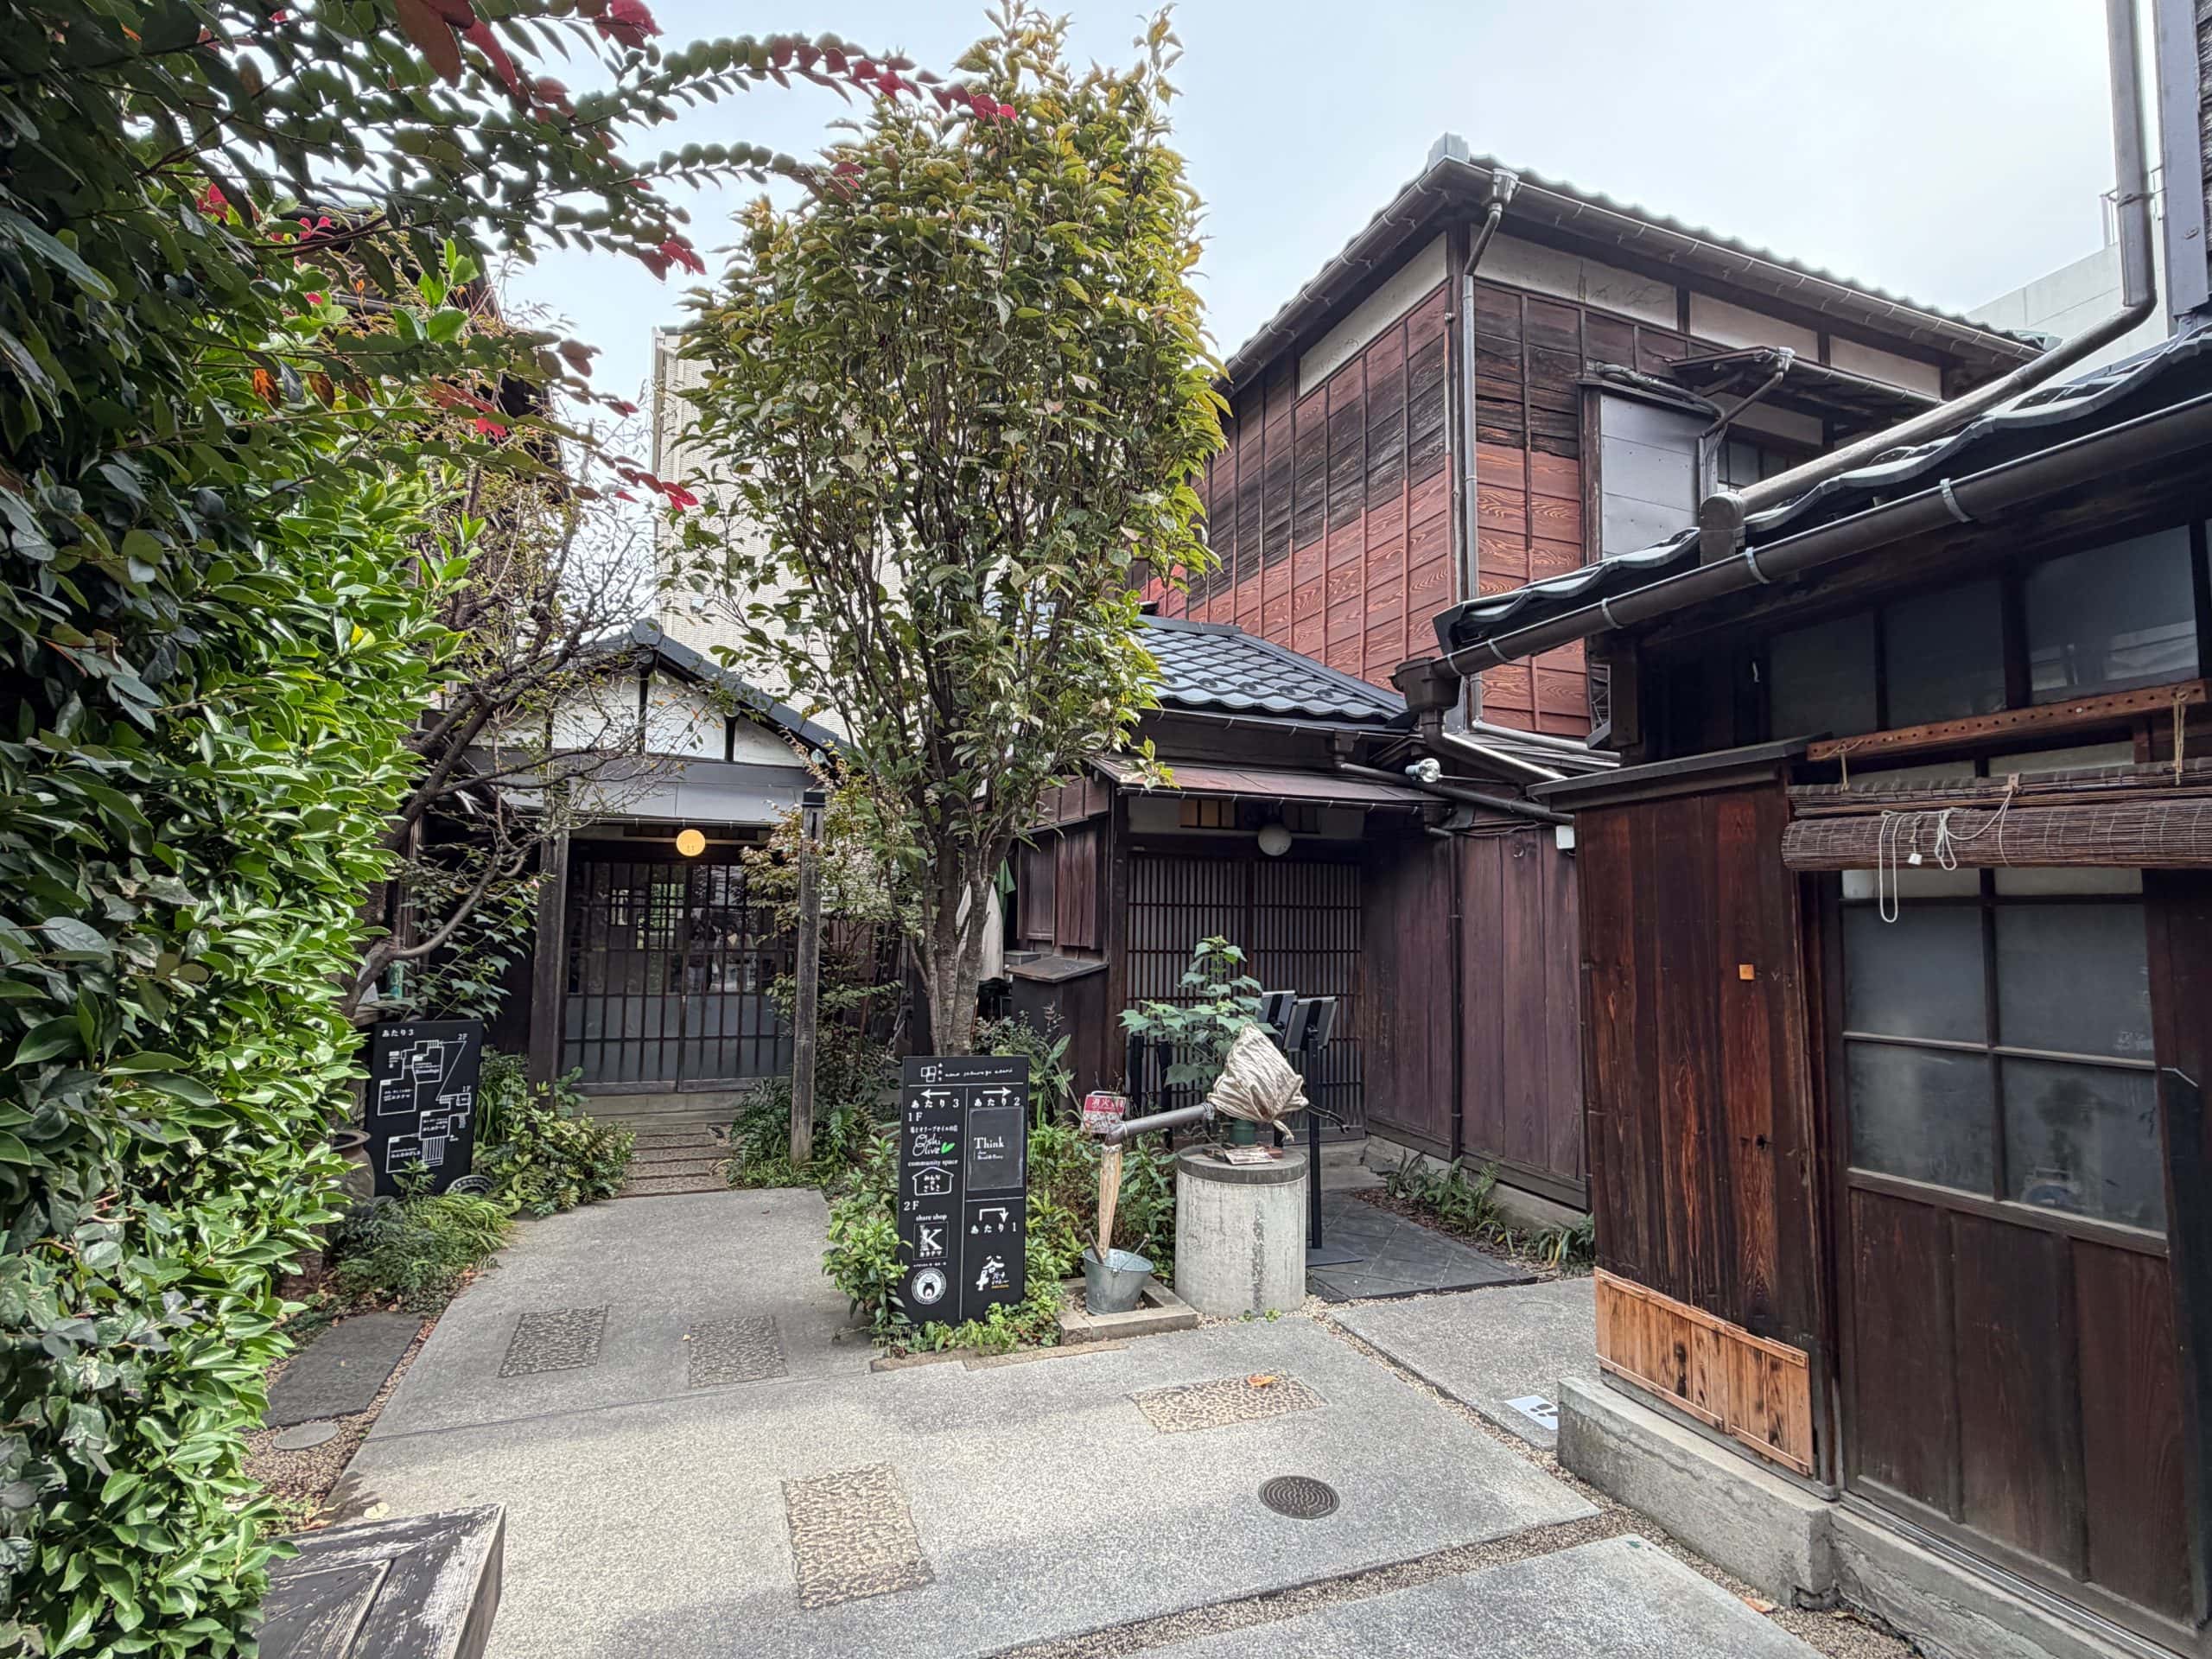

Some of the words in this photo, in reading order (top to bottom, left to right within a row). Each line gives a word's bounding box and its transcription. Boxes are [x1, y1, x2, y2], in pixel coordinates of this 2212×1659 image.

[908, 1112, 923, 1122] 1F
[974, 1136, 1005, 1149] Think
[903, 1200, 919, 1211] 2F
